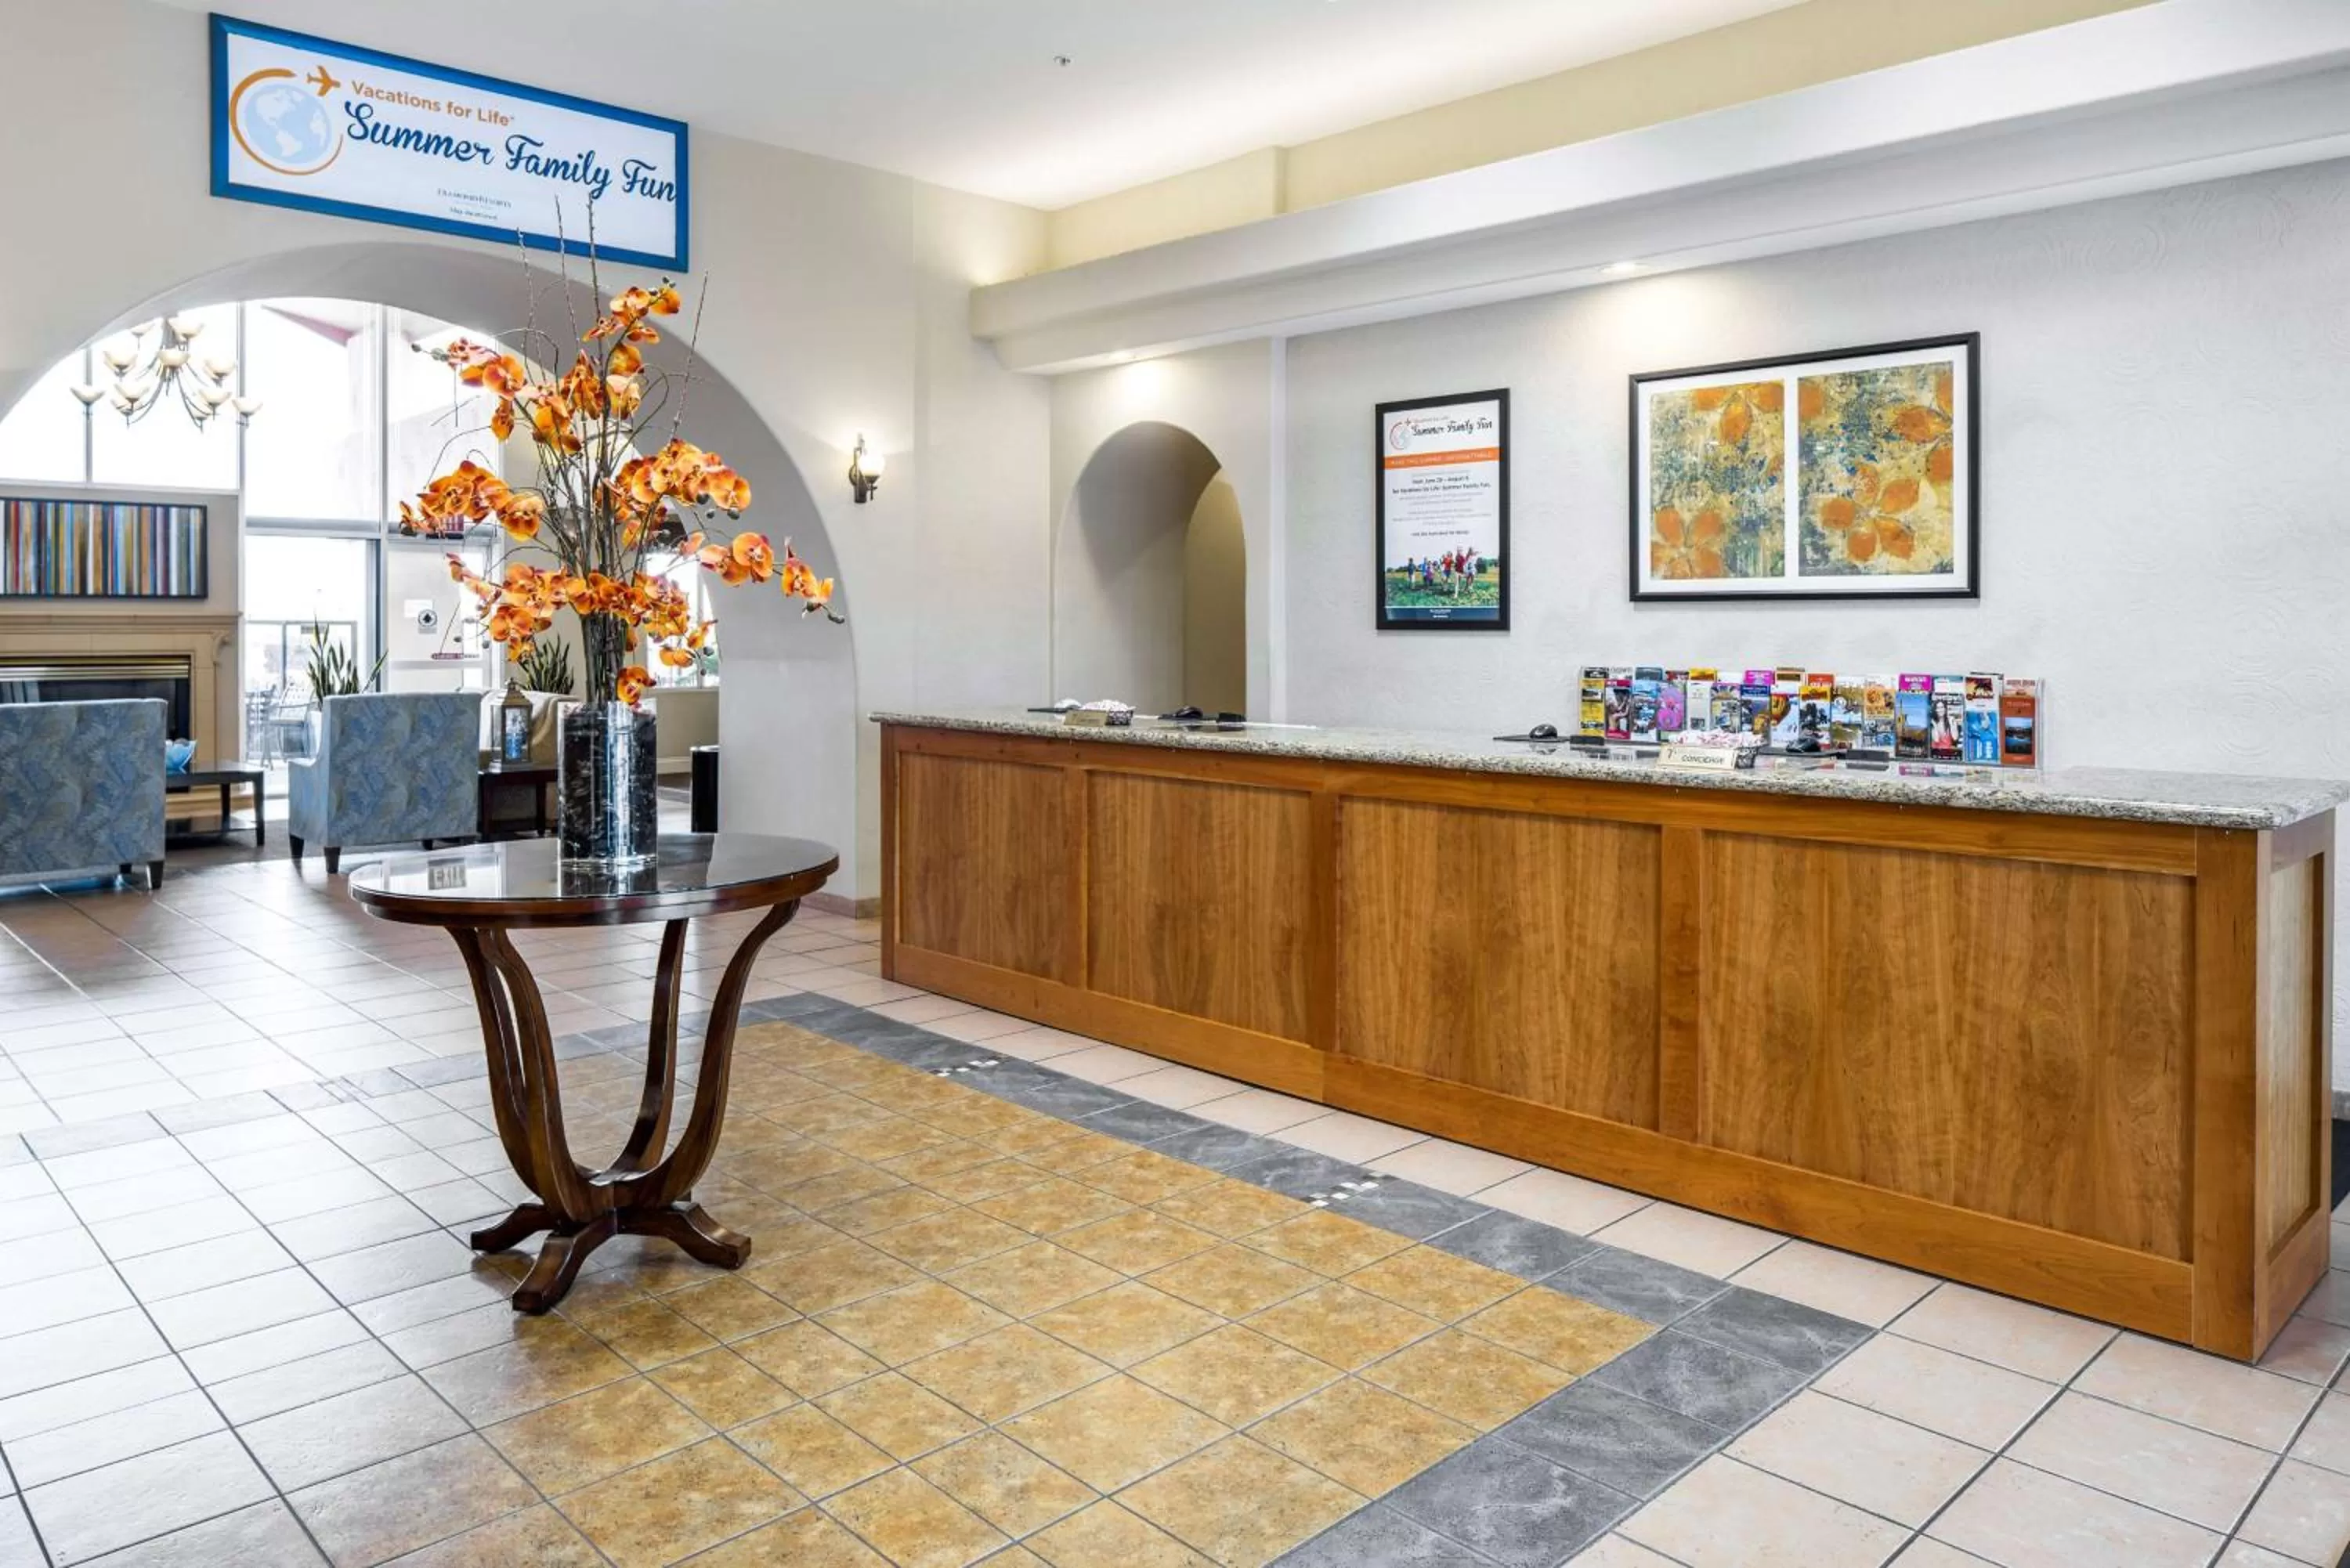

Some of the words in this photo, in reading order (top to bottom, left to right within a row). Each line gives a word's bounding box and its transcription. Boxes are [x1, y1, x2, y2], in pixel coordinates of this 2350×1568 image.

[352, 81, 442, 112] Vacations
[446, 100, 472, 118] for
[345, 100, 495, 164] Summer
[505, 134, 613, 199] Family
[622, 159, 676, 202] Fun
